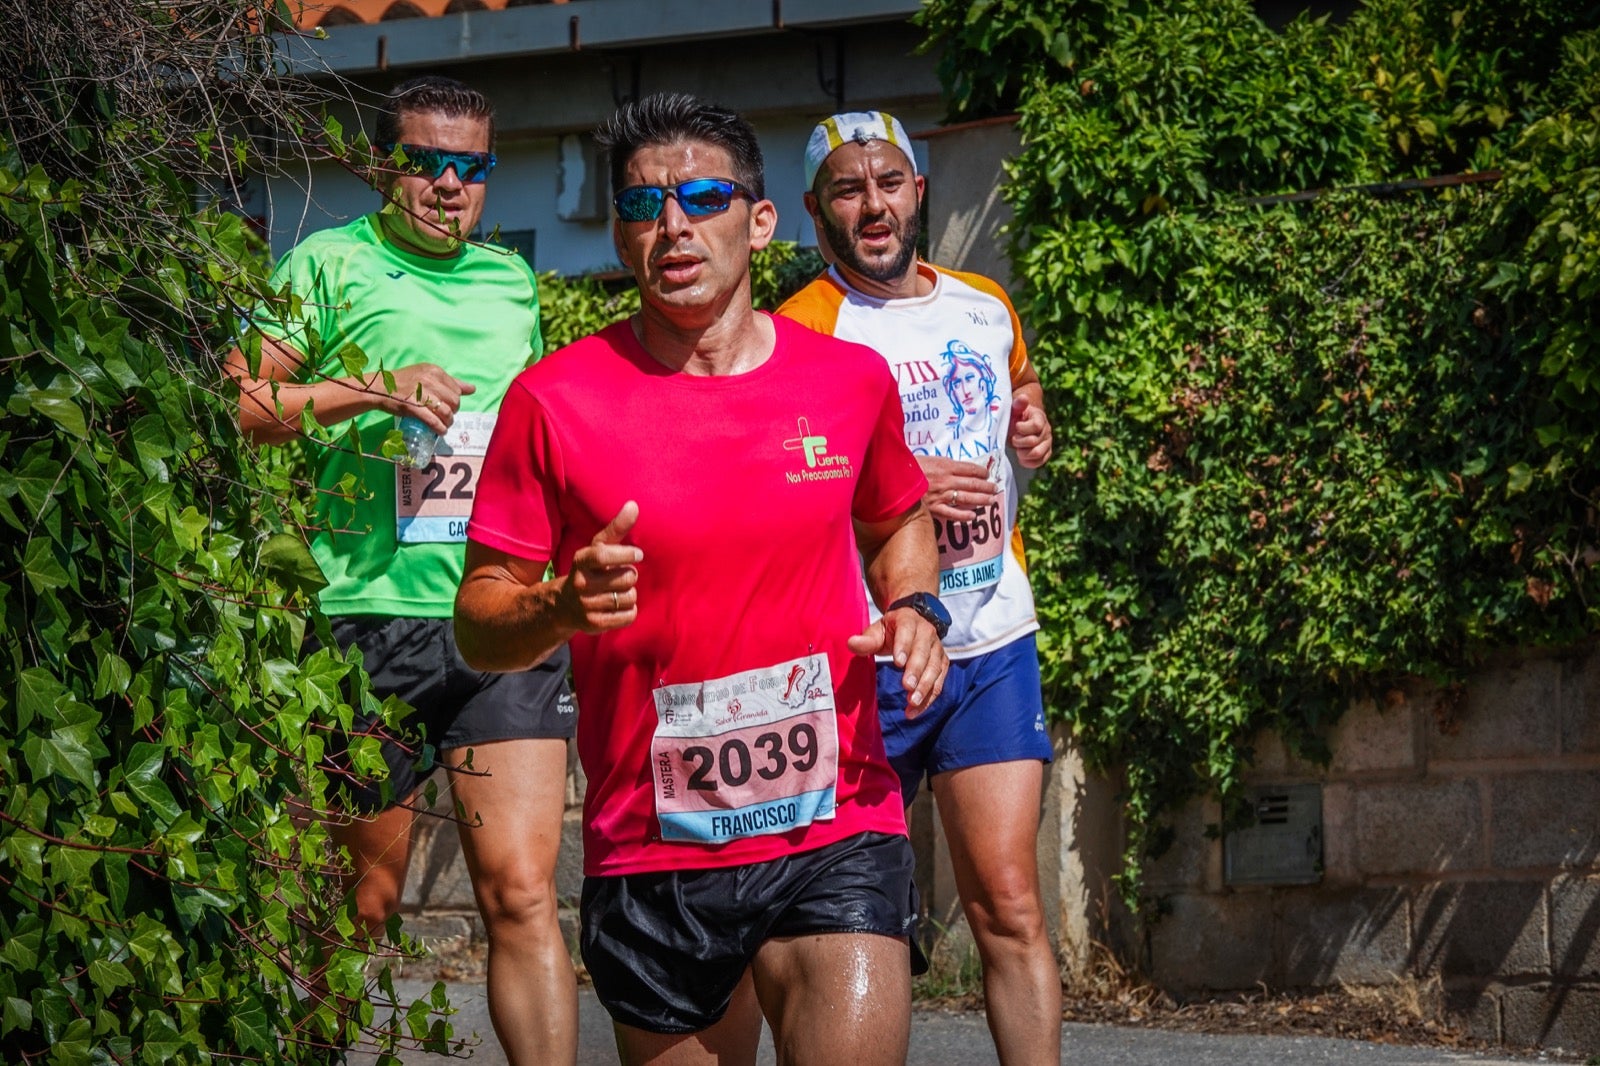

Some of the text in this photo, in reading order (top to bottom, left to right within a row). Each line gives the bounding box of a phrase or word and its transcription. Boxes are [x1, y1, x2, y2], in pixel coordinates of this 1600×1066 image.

[421, 462, 473, 500] 22
[942, 563, 995, 590] JOSÉ JAIME
[735, 709, 768, 722] Granada
[682, 723, 818, 791] 2039
[659, 760, 675, 799] MASTER
[712, 803, 796, 836] FRANCISCO
